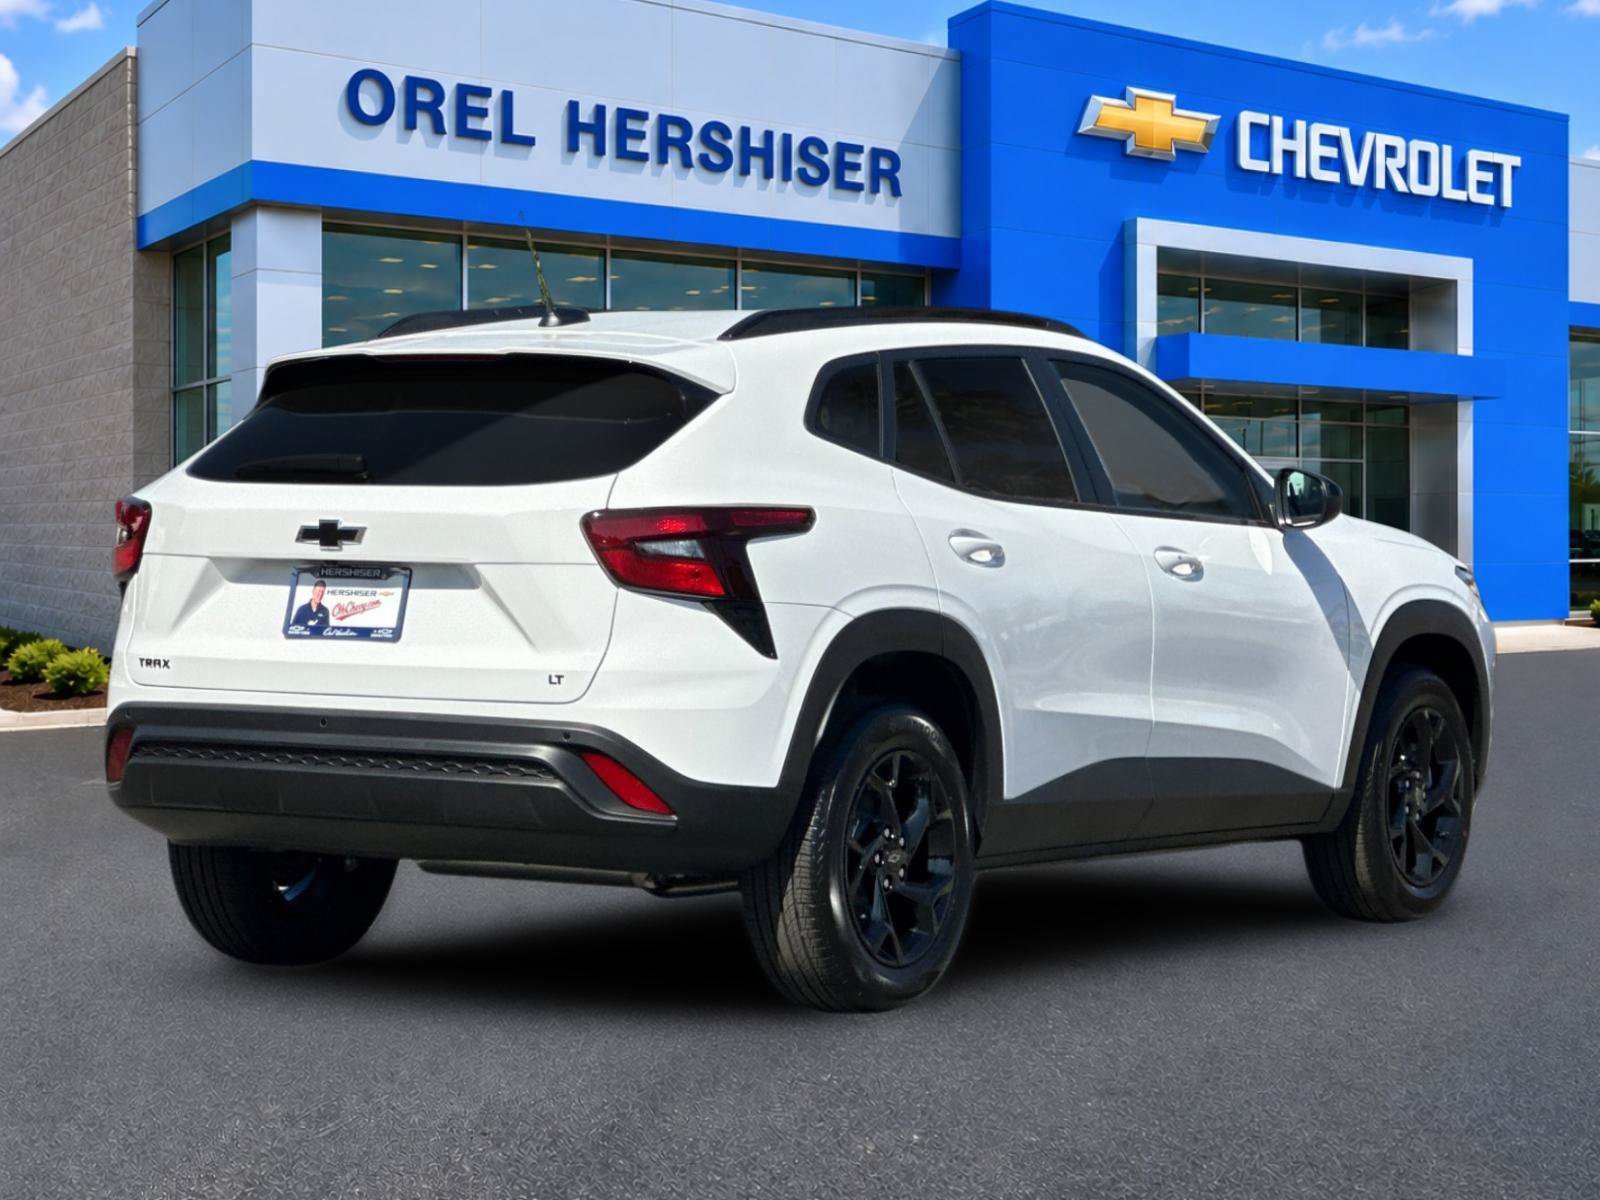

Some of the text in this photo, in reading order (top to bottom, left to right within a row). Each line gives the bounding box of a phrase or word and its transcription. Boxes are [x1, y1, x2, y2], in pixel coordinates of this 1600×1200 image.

[346, 68, 902, 197] OREL HERSHISER
[1237, 110, 1522, 208] CHEVROLET
[320, 568, 382, 577] HERSHISER
[327, 589, 377, 597] HERSHISER
[139, 657, 171, 670] TRAX
[548, 674, 565, 685] LT
